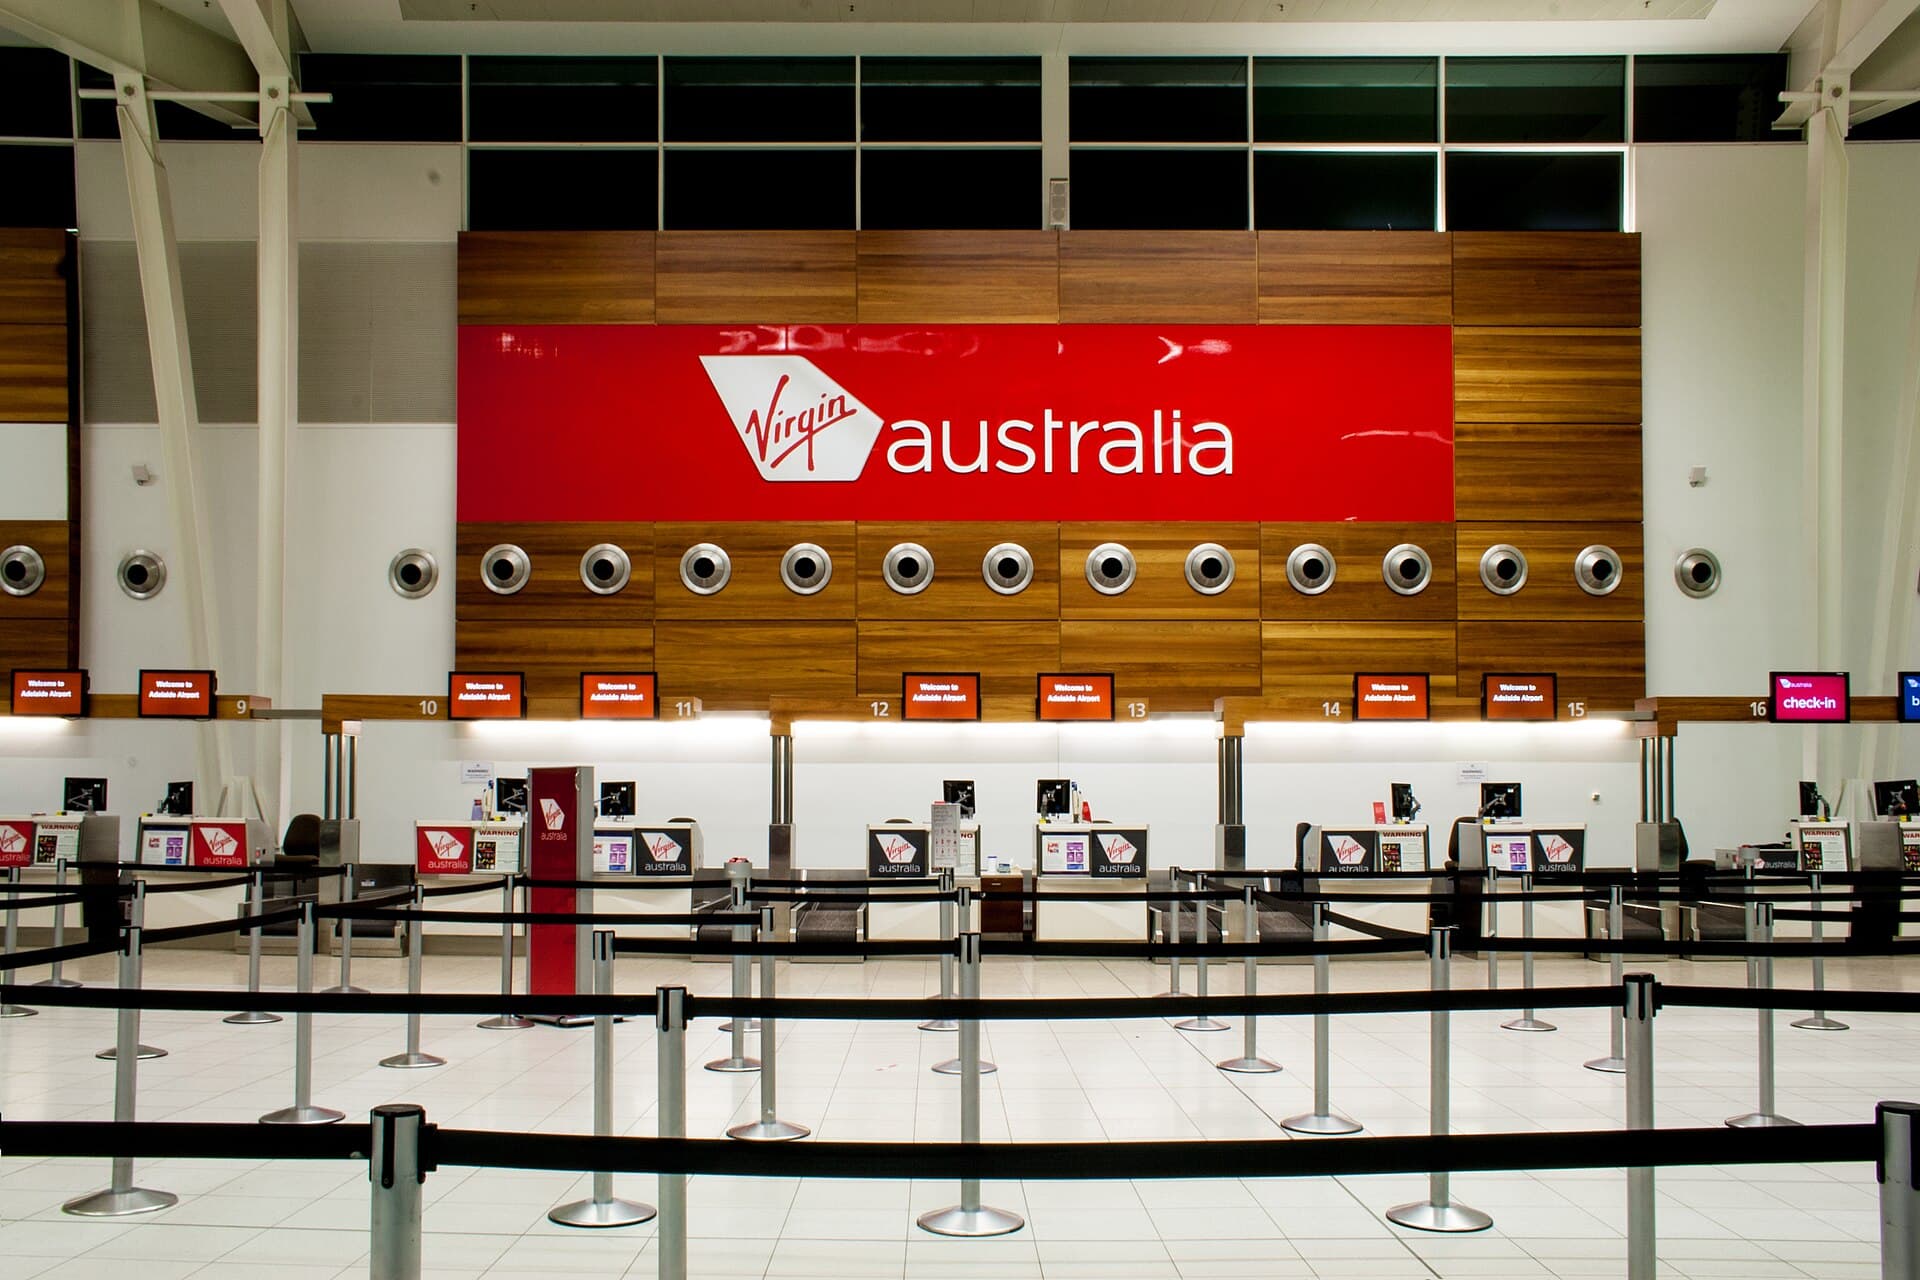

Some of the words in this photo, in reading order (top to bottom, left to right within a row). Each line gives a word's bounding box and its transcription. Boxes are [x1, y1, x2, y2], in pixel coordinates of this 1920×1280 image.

[745, 374, 857, 471] Virgin
[886, 408, 1234, 475] australia
[28, 679, 57, 687] Welcome
[156, 680, 185, 688] Welcome
[466, 682, 495, 690] Welcome
[598, 682, 628, 690] Welcome
[920, 683, 950, 691] Welcome
[1054, 683, 1085, 691] Welcome
[1371, 683, 1401, 691] Welcome
[1500, 683, 1528, 691] Welcome
[21, 689, 48, 697] Adelaide
[49, 689, 72, 697] Airport
[149, 690, 176, 698] Adelaide
[177, 690, 200, 698] Airport
[458, 692, 486, 700] Adelaide
[487, 692, 511, 700] Airport
[591, 692, 619, 701] Adelaide
[619, 692, 644, 701] Airport
[913, 693, 941, 702] Adelaide
[942, 693, 966, 702] Airport
[1364, 693, 1392, 701] Adelaide
[1393, 693, 1416, 701] Airport
[1493, 693, 1520, 702] Adelaide
[1521, 693, 1543, 702] Airport
[1047, 694, 1076, 702] Adelaide
[1077, 694, 1100, 702] Airport
[1783, 696, 1837, 709] check-in
[236, 699, 247, 715] 9
[419, 700, 438, 716] 10
[675, 701, 692, 717] 11
[870, 701, 889, 717] 12
[1128, 702, 1146, 718] 13
[1322, 702, 1341, 717] 14
[1567, 702, 1585, 717] 15
[1750, 701, 1767, 717] 16
[541, 832, 568, 841] australia
[209, 832, 233, 853] Virgin
[435, 835, 459, 857] Virgin
[652, 836, 677, 859] Virgin
[886, 838, 911, 860] Virgin
[1106, 838, 1132, 861] Virgin
[1336, 839, 1360, 862] Virgin
[1546, 839, 1568, 861] Virgin
[0, 853, 31, 862] ustralia
[203, 857, 243, 866] australia
[428, 860, 469, 869] australia
[644, 862, 687, 872] australia
[878, 864, 921, 873] australia
[1099, 864, 1141, 873] australia
[1538, 863, 1577, 872] australia
